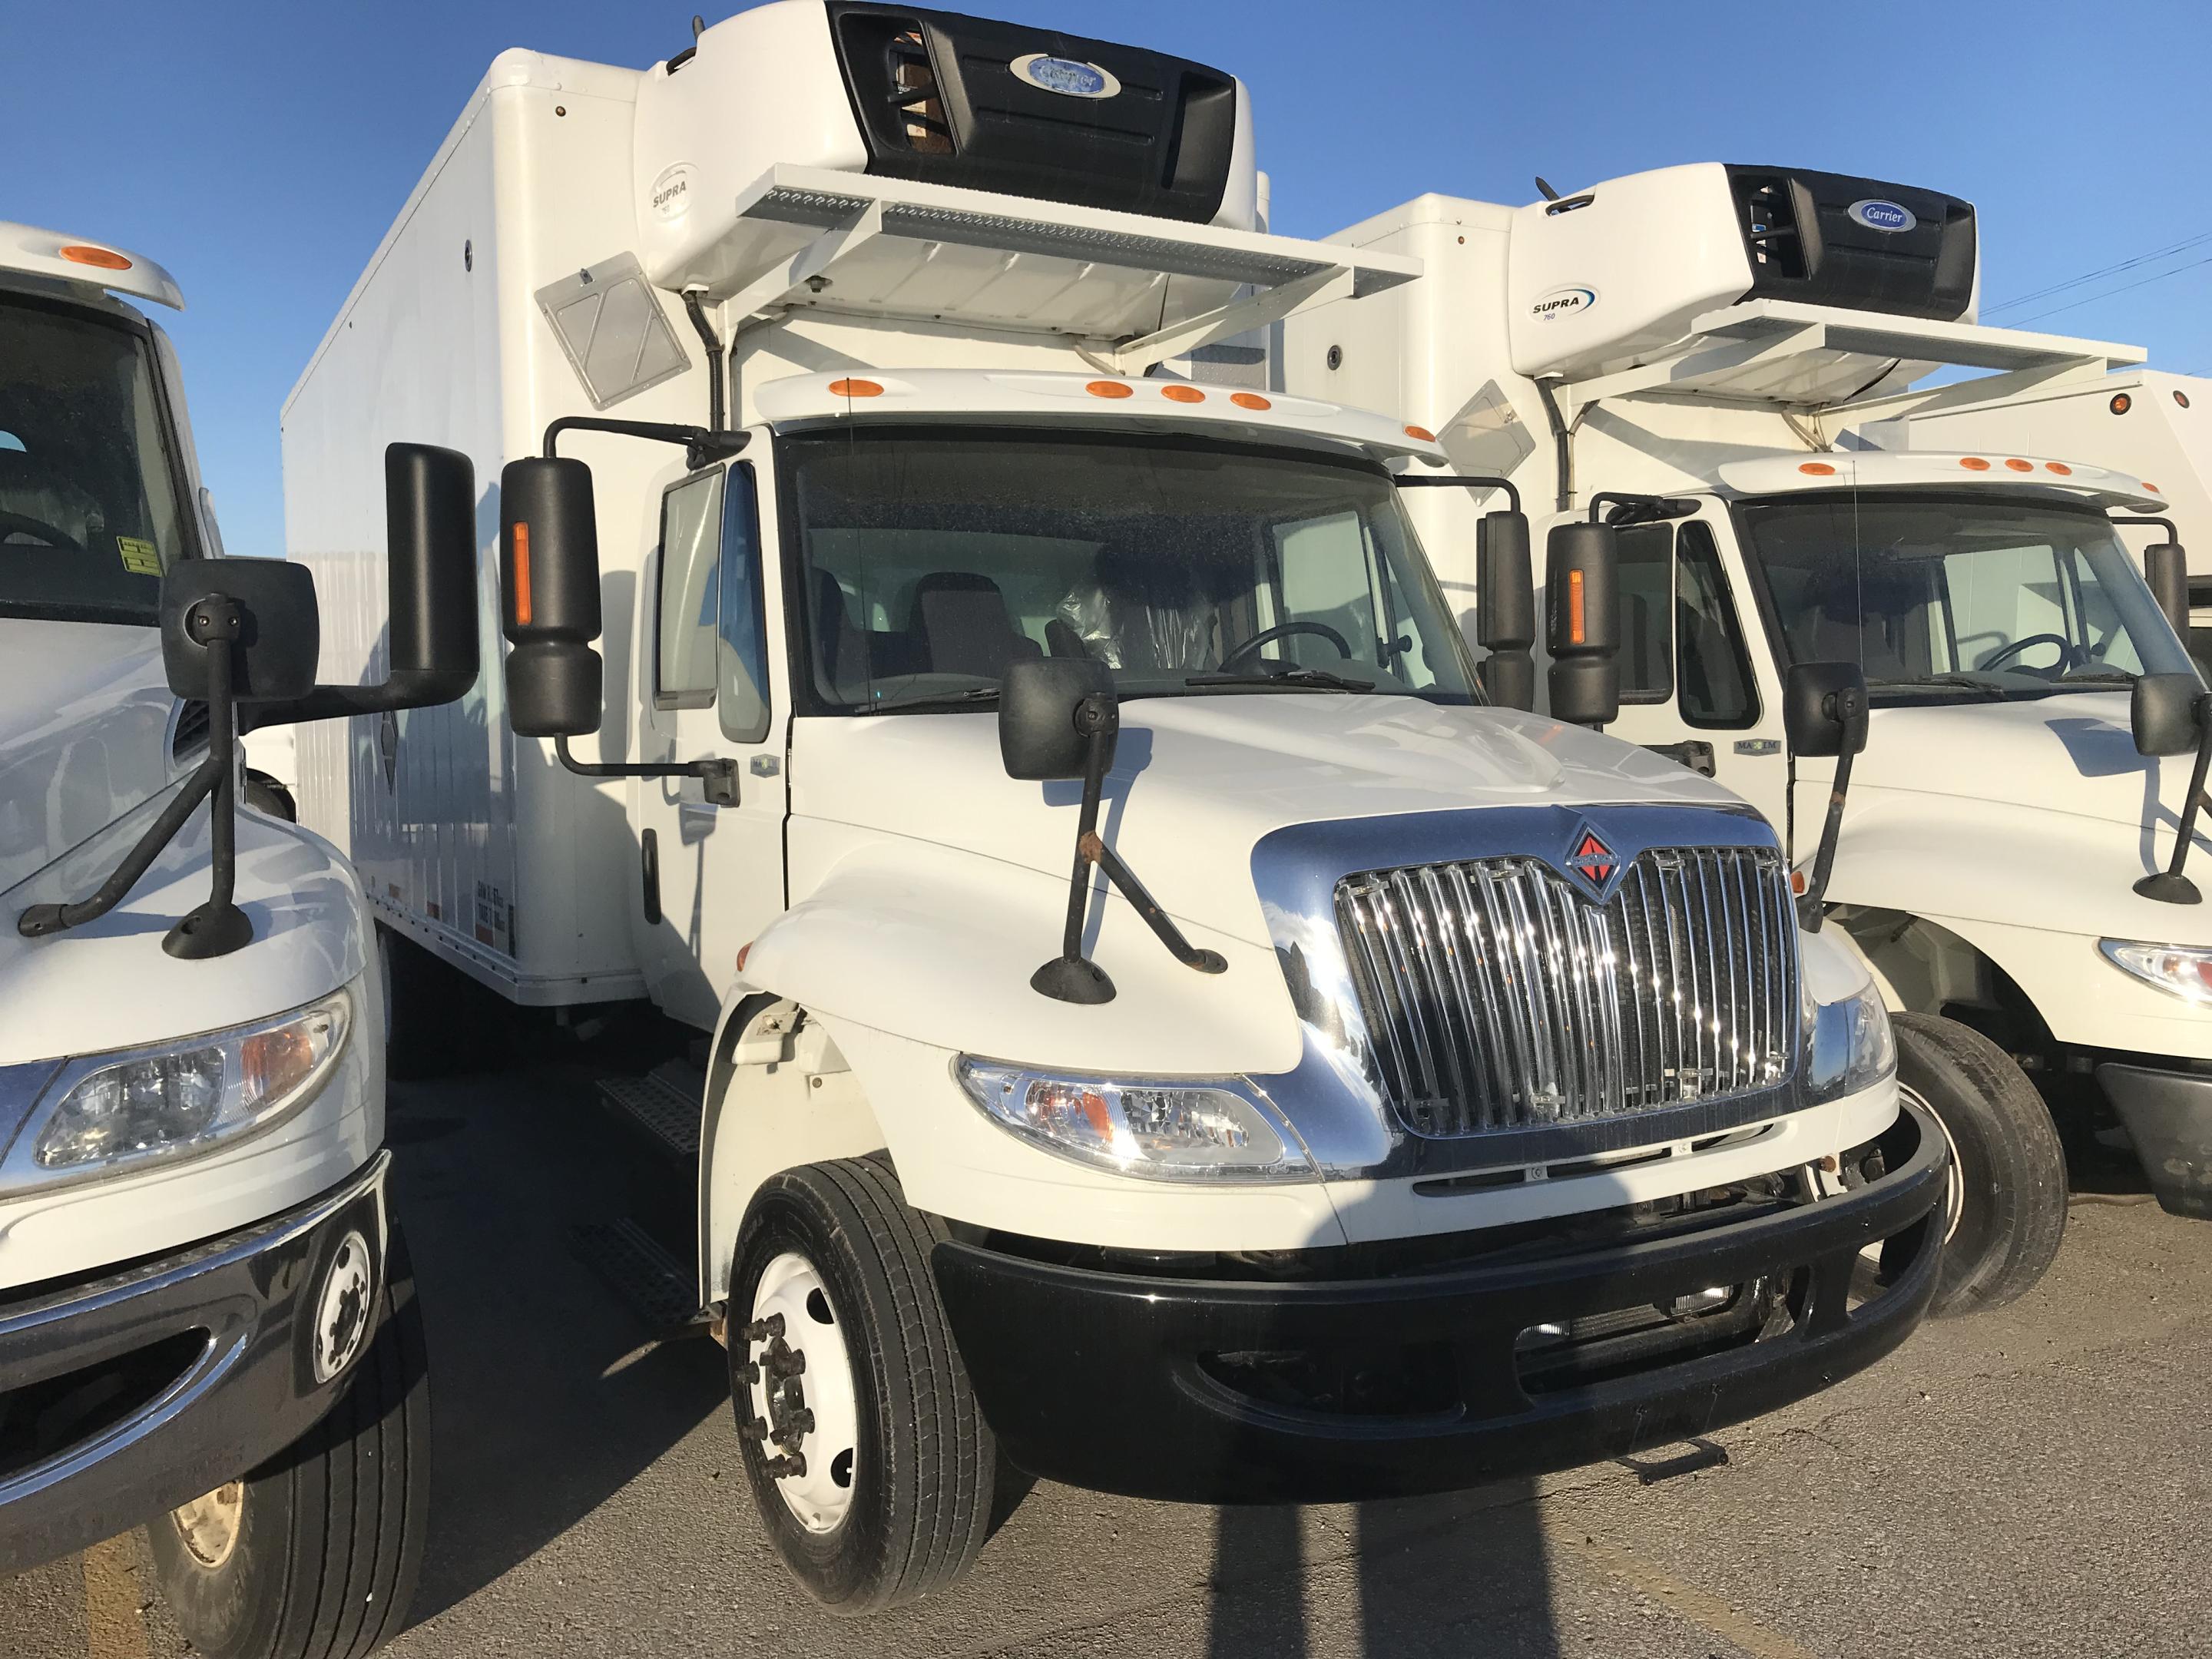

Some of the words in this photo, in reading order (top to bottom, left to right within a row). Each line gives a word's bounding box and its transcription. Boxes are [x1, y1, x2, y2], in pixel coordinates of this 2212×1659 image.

[653, 180, 687, 208] SUPRA
[1866, 207, 1903, 223] Carrier
[1532, 296, 1580, 314] SUPRA
[1543, 313, 1555, 321] 760
[1737, 741, 1777, 750] MAXIM
